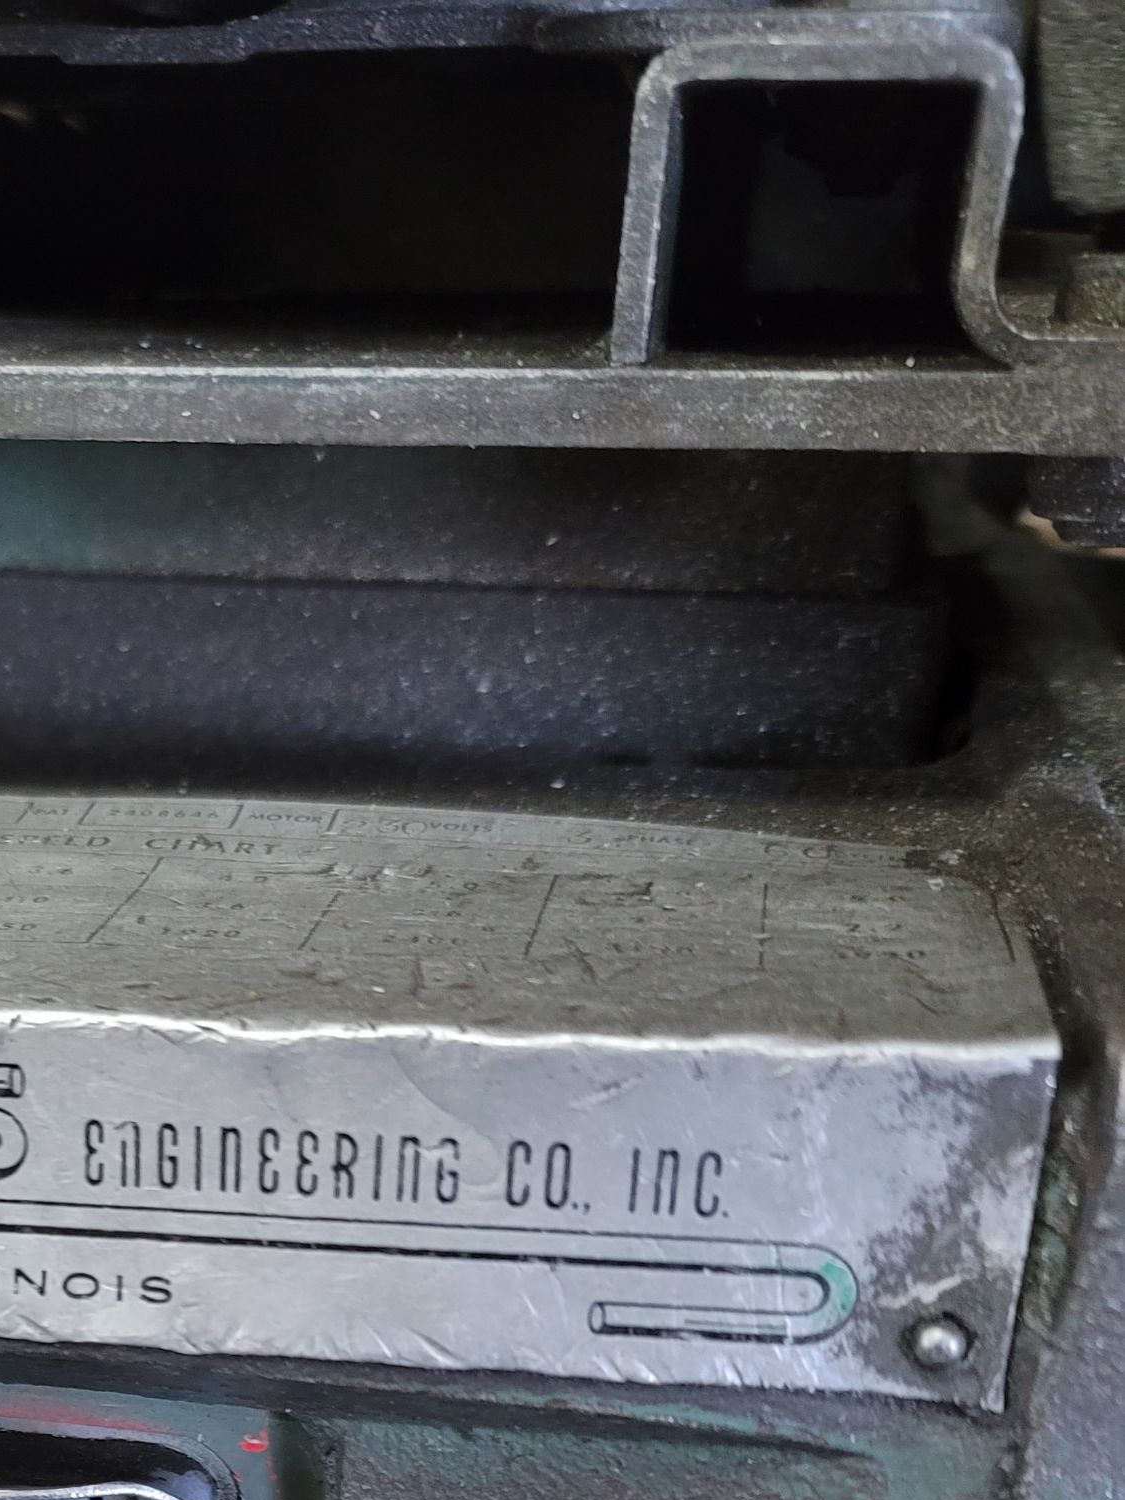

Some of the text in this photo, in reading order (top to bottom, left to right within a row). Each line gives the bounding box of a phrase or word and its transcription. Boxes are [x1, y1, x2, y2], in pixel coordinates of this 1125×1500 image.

[248, 813, 324, 824] MOTOR
[144, 838, 282, 856] CHART
[82, 1118, 461, 1206] ENGINEERING
[627, 1147, 732, 1220] INC.
